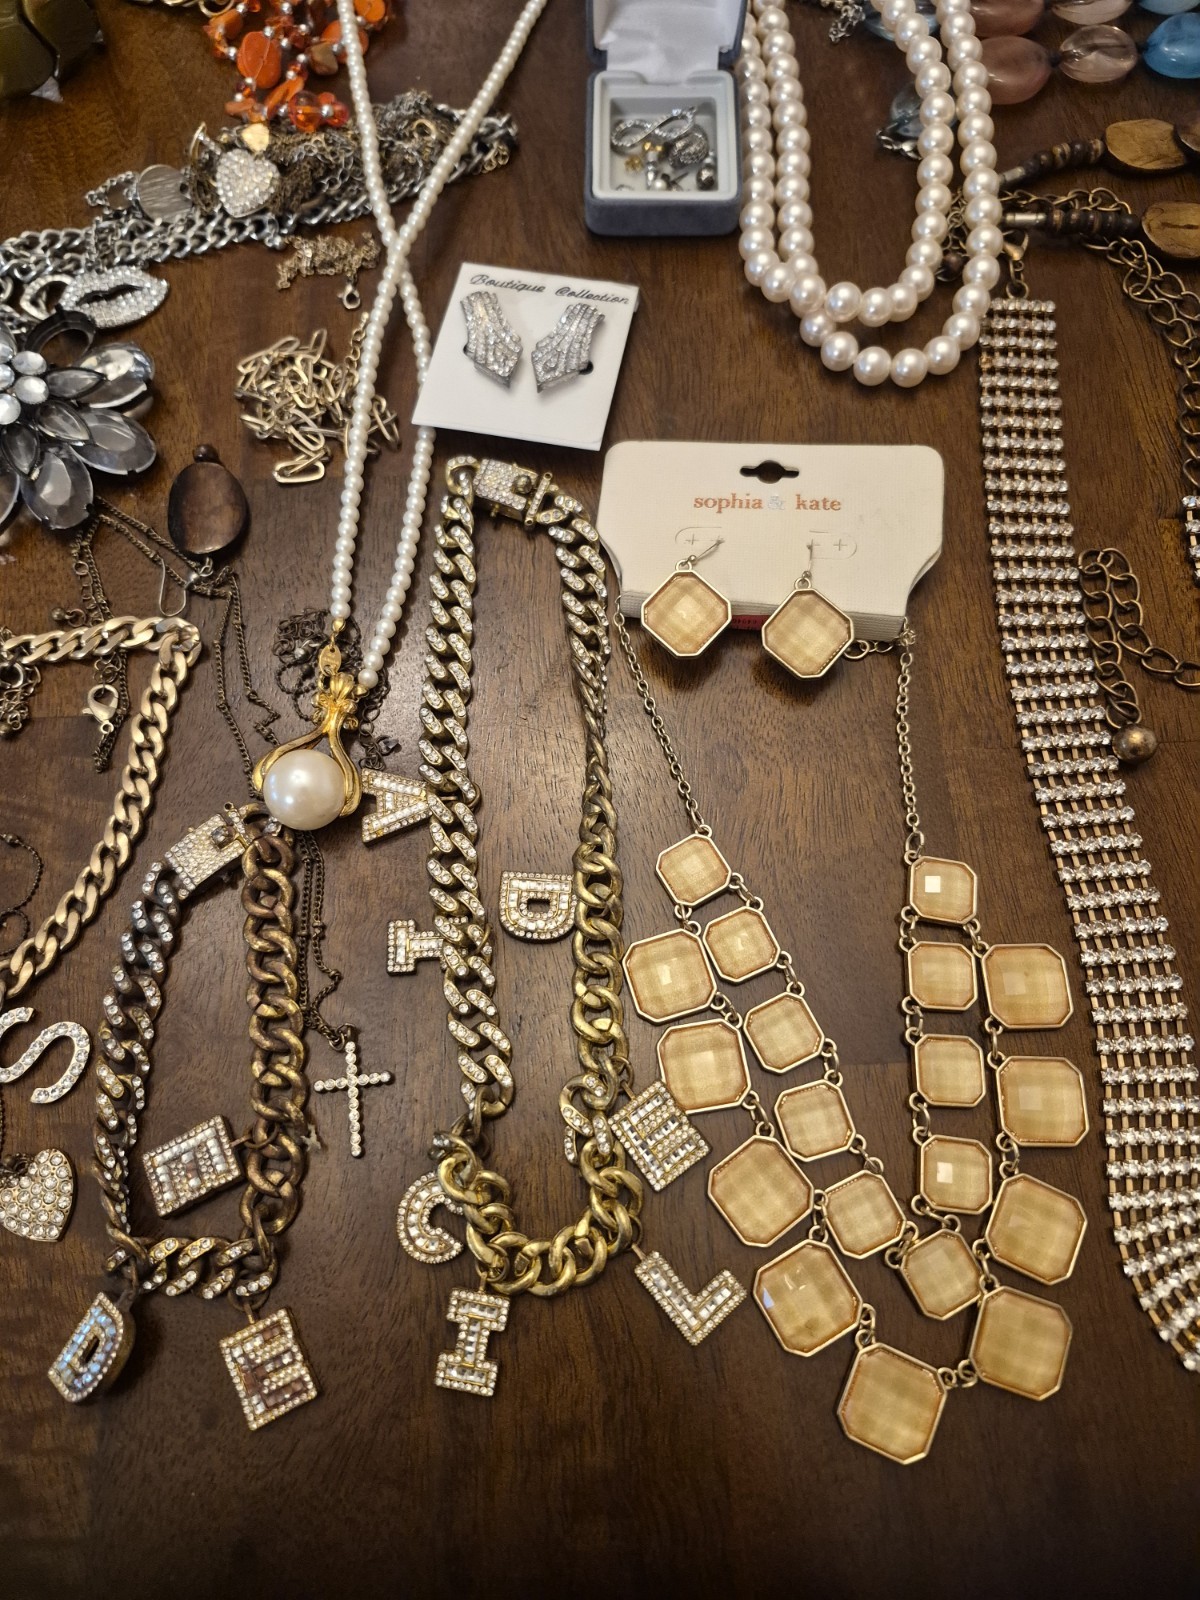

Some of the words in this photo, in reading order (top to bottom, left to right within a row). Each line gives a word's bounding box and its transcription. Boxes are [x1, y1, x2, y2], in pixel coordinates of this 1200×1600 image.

[470, 274, 546, 293] Boutique
[554, 286, 630, 304] Collection
[693, 493, 763, 514] sophia
[795, 494, 842, 511] kate
